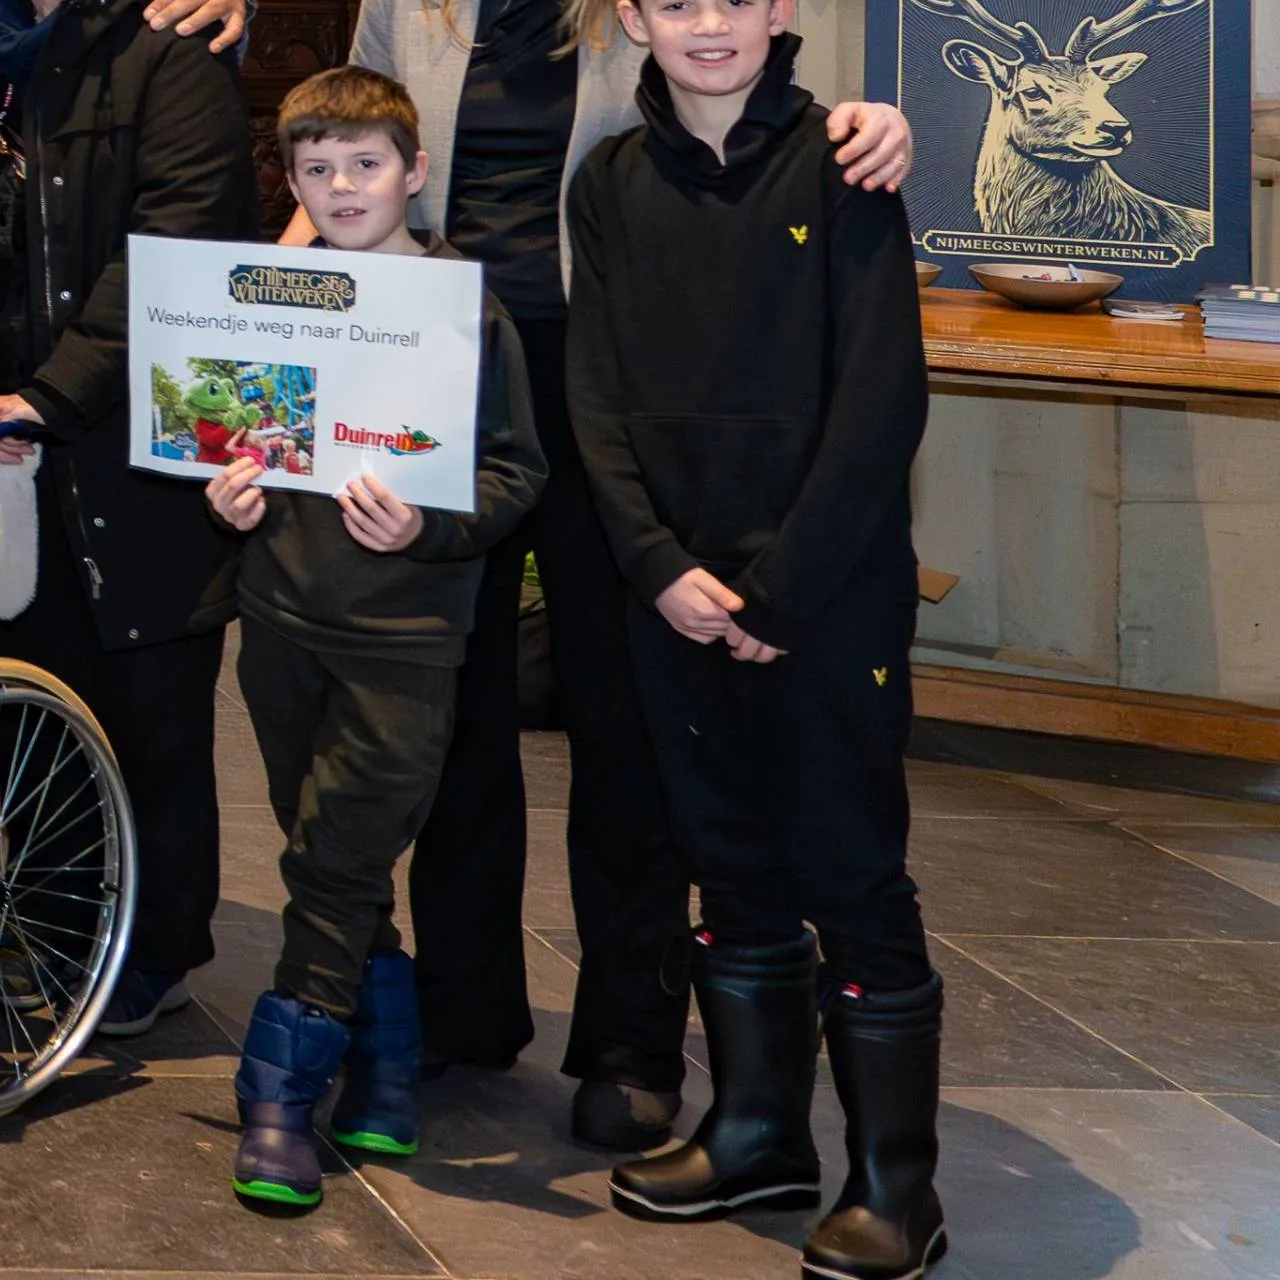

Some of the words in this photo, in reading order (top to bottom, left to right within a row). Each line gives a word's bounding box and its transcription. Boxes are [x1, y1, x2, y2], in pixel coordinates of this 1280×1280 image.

[936, 237, 1170, 261] NIJMEEGSEWINTERWEKEN.NL
[231, 279, 346, 310] WINTERWEKEN
[147, 307, 248, 333] Weekendje
[255, 318, 294, 339] weg
[301, 323, 342, 341] naar
[350, 324, 420, 348] Duinrell
